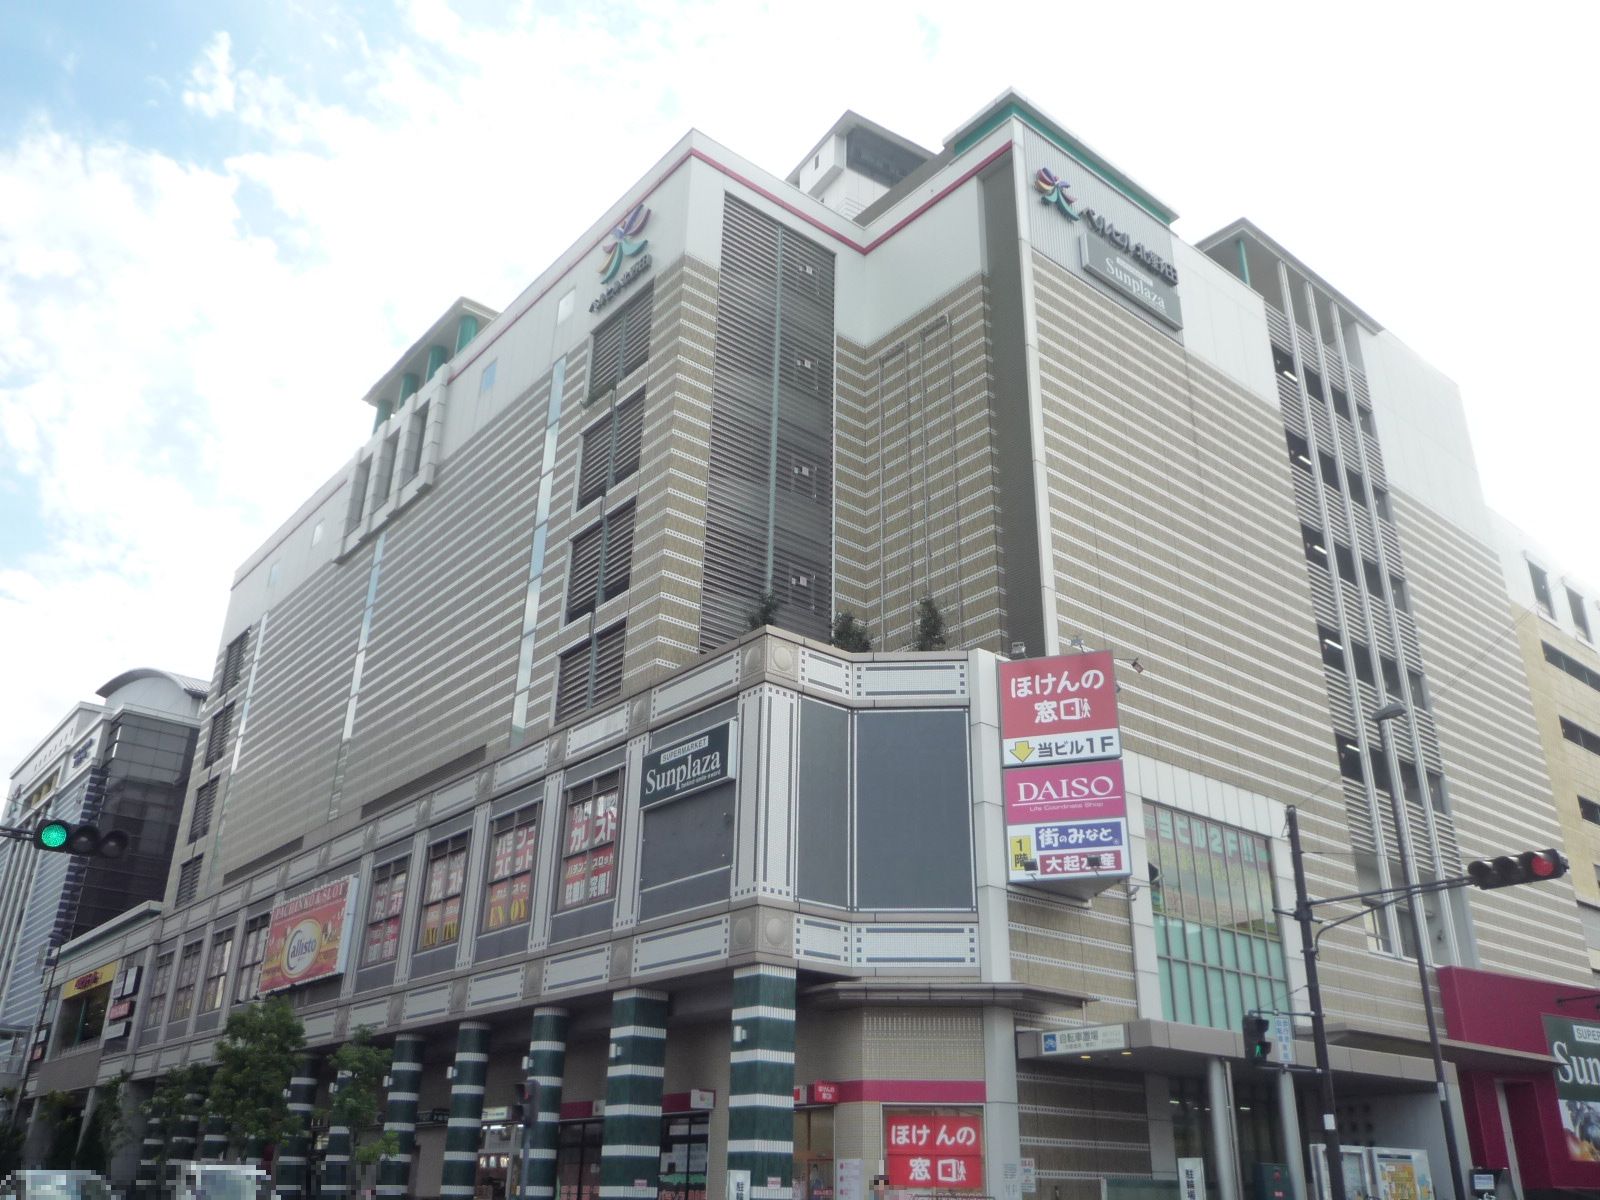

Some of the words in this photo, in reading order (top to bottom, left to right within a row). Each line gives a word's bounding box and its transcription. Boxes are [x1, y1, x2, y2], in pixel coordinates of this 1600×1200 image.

[1105, 257, 1167, 311] Sunplaza
[1010, 669, 1105, 698] ほけんの
[1034, 698, 1090, 724] 窓口
[662, 738, 708, 762] SUPERMARKET
[645, 751, 721, 795] Sunplaza
[1017, 776, 1114, 802] DAISO
[1038, 828, 1113, 849] 街のみなと
[891, 1124, 976, 1146] ほけんの
[909, 1157, 966, 1182] 窓口
